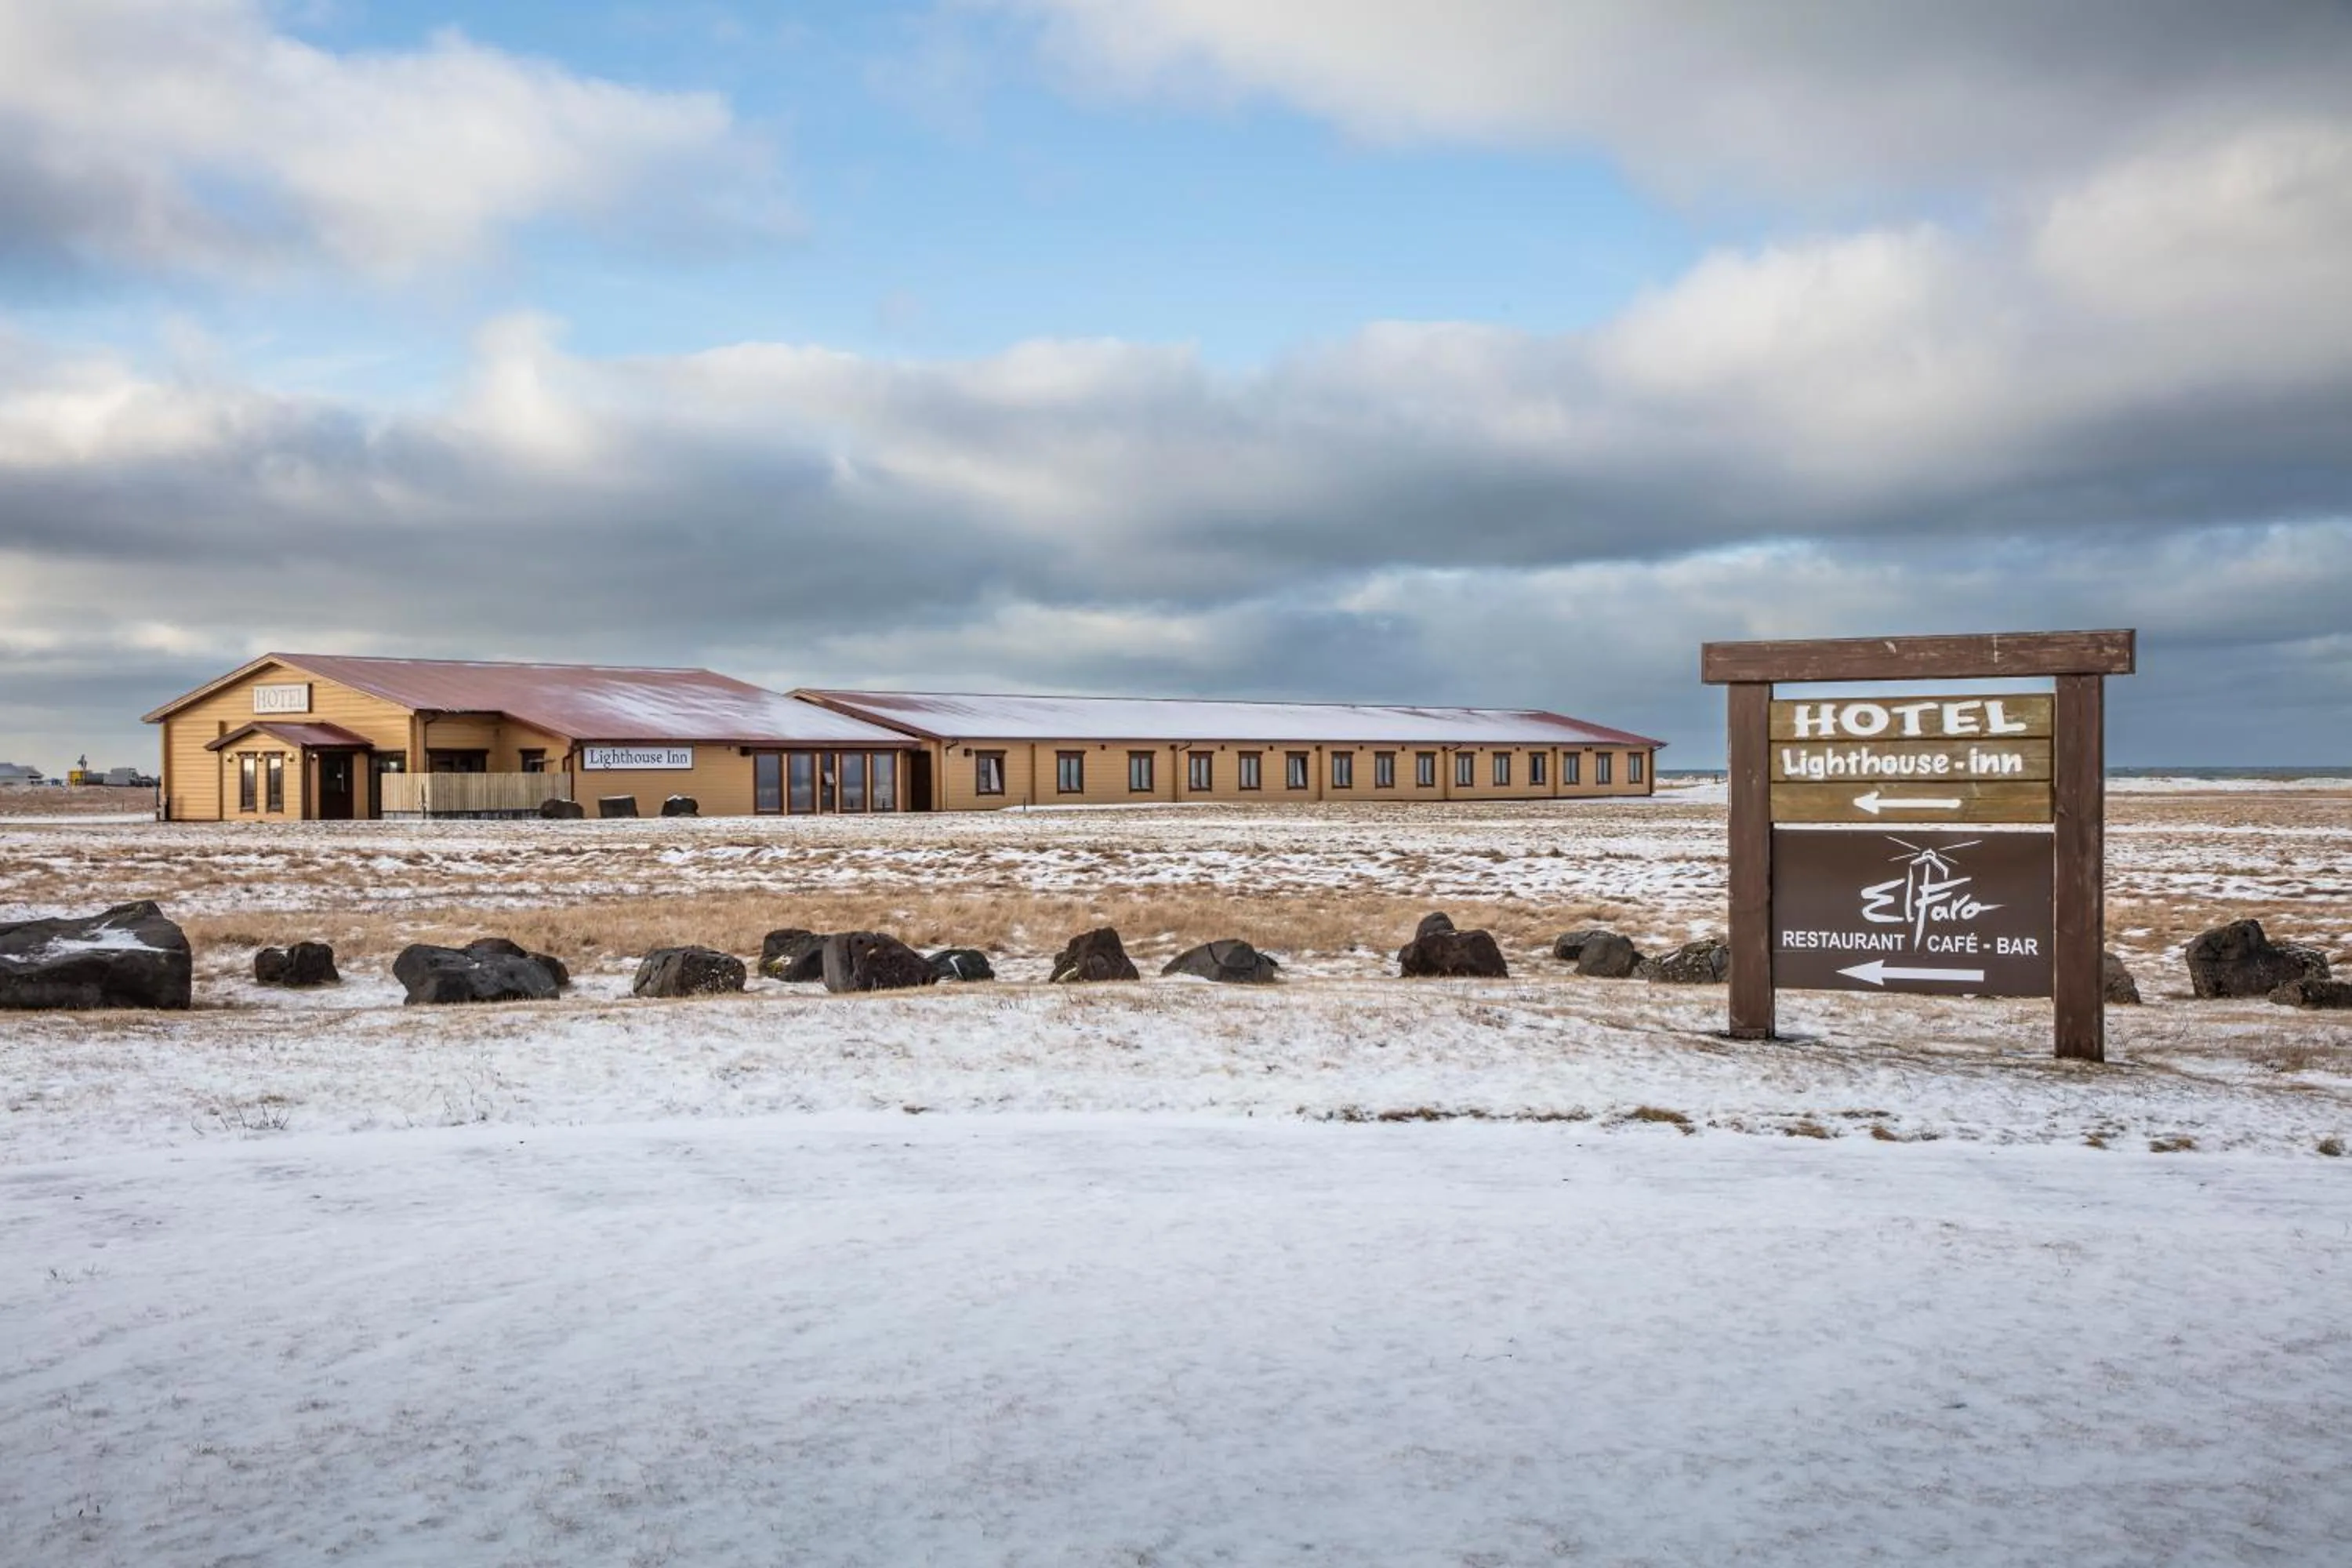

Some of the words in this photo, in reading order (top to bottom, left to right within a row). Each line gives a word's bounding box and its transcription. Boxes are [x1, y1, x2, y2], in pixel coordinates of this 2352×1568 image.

[256, 689, 305, 708] HOTEL
[1794, 700, 2027, 738] HOTEL
[589, 749, 663, 768] Lighthouse
[666, 750, 688, 764] Inn
[1781, 931, 1905, 951] RESTAURANT
[1926, 933, 1978, 954] CAFÉ
[1997, 937, 2039, 956] BAR
